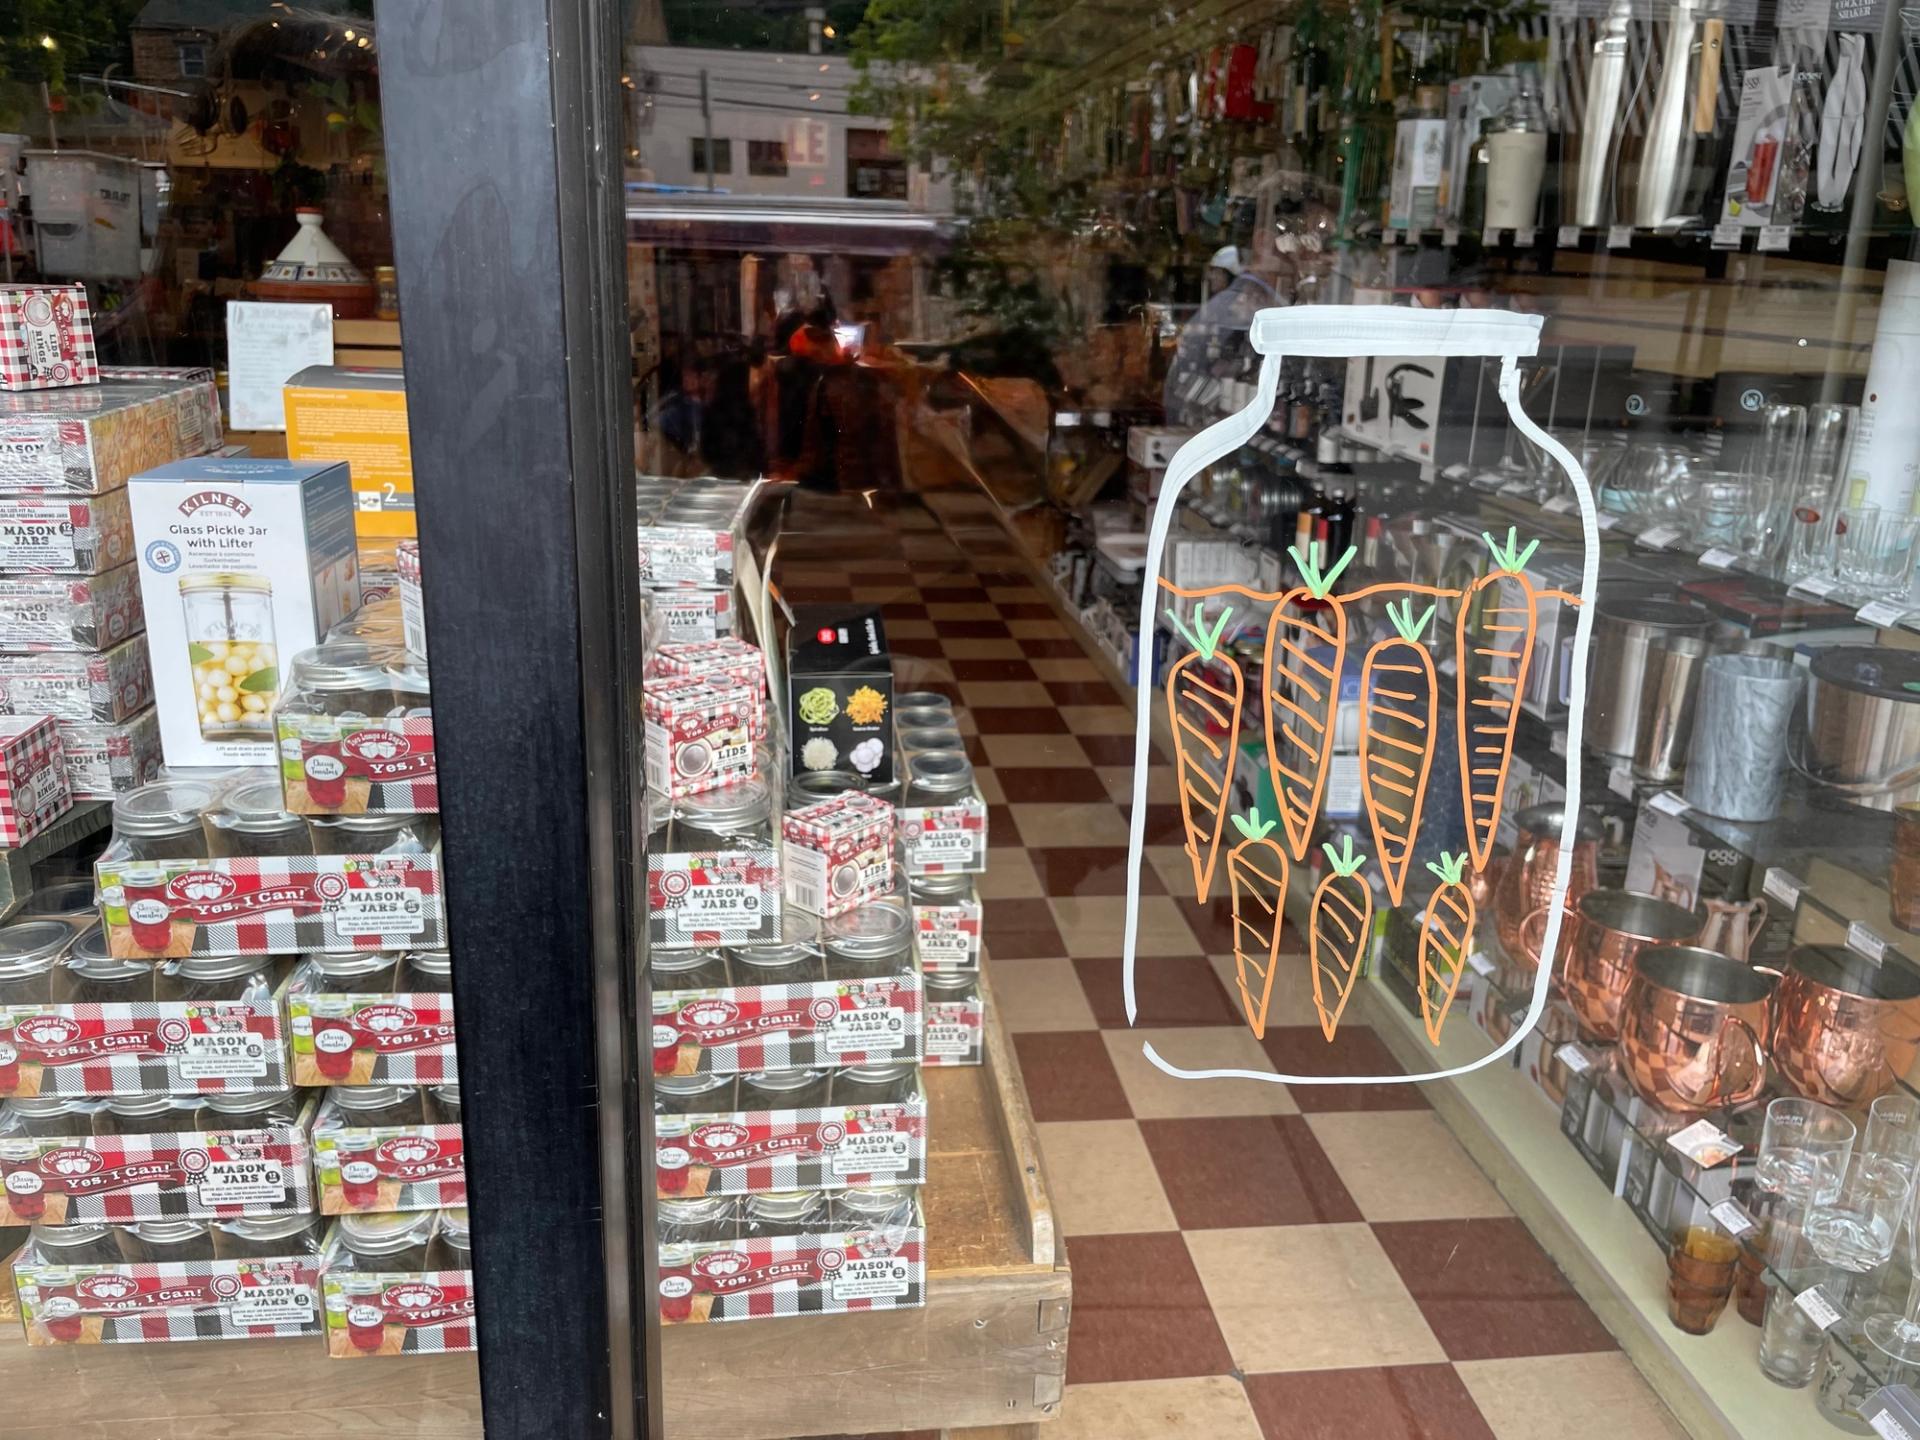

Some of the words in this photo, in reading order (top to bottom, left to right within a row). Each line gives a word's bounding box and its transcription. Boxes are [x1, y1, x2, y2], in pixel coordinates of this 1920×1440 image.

[36, 330, 47, 364] RINGS
[50, 333, 59, 358] LIDS
[383, 482, 398, 503] 2
[181, 493, 247, 514] KILNER
[4, 526, 56, 536] MASON
[169, 524, 204, 535] Glass
[207, 524, 245, 536] Pickle
[248, 525, 268, 536] Jar
[14, 537, 49, 546] JARS
[187, 538, 216, 549] with
[220, 538, 253, 549] Lifter
[718, 745, 748, 759] LIDS
[369, 761, 413, 774] Yes,
[418, 756, 427, 766] I
[37, 769, 51, 783] LIDS
[864, 862, 887, 878] LIDS
[172, 877, 185, 889] Two
[185, 874, 207, 884] Lumps
[350, 891, 405, 902] MASON
[692, 888, 745, 899] MASON
[197, 902, 239, 916] Yes,
[243, 895, 253, 906] I
[257, 889, 305, 902] Can!
[360, 902, 398, 912] JARS
[701, 899, 737, 910] JARS
[840, 1012, 889, 1023] MASON
[701, 1027, 741, 1039] Yes,
[745, 1020, 753, 1029] I
[758, 1013, 800, 1026] Can!
[848, 1022, 882, 1032] JARS
[89, 1040, 98, 1050] I
[103, 1034, 149, 1047] Can!
[193, 1036, 247, 1047] MASON
[377, 1033, 419, 1046] Yes,
[423, 1028, 432, 1038] I
[205, 1047, 240, 1056] JARS
[847, 1135, 894, 1146] MASON
[712, 1149, 751, 1160] Yes,
[754, 1142, 762, 1152] I
[767, 1136, 808, 1149] Can!
[45, 1153, 58, 1164] Two
[57, 1151, 76, 1160] Lumps
[212, 1163, 266, 1174] MASON
[66, 1175, 107, 1189] Yes,
[111, 1170, 120, 1181] I
[125, 1163, 171, 1178] Can!
[223, 1174, 259, 1184] JARS
[847, 1260, 893, 1271] MASON
[714, 1275, 752, 1288] Yes,
[756, 1270, 764, 1279] I
[769, 1263, 809, 1275] Can!
[854, 1270, 887, 1280] JARS
[146, 1293, 155, 1303] I
[159, 1288, 203, 1300] Can!
[244, 1288, 295, 1298] MASON
[407, 1307, 446, 1320] Yes,
[450, 1302, 458, 1312] I
